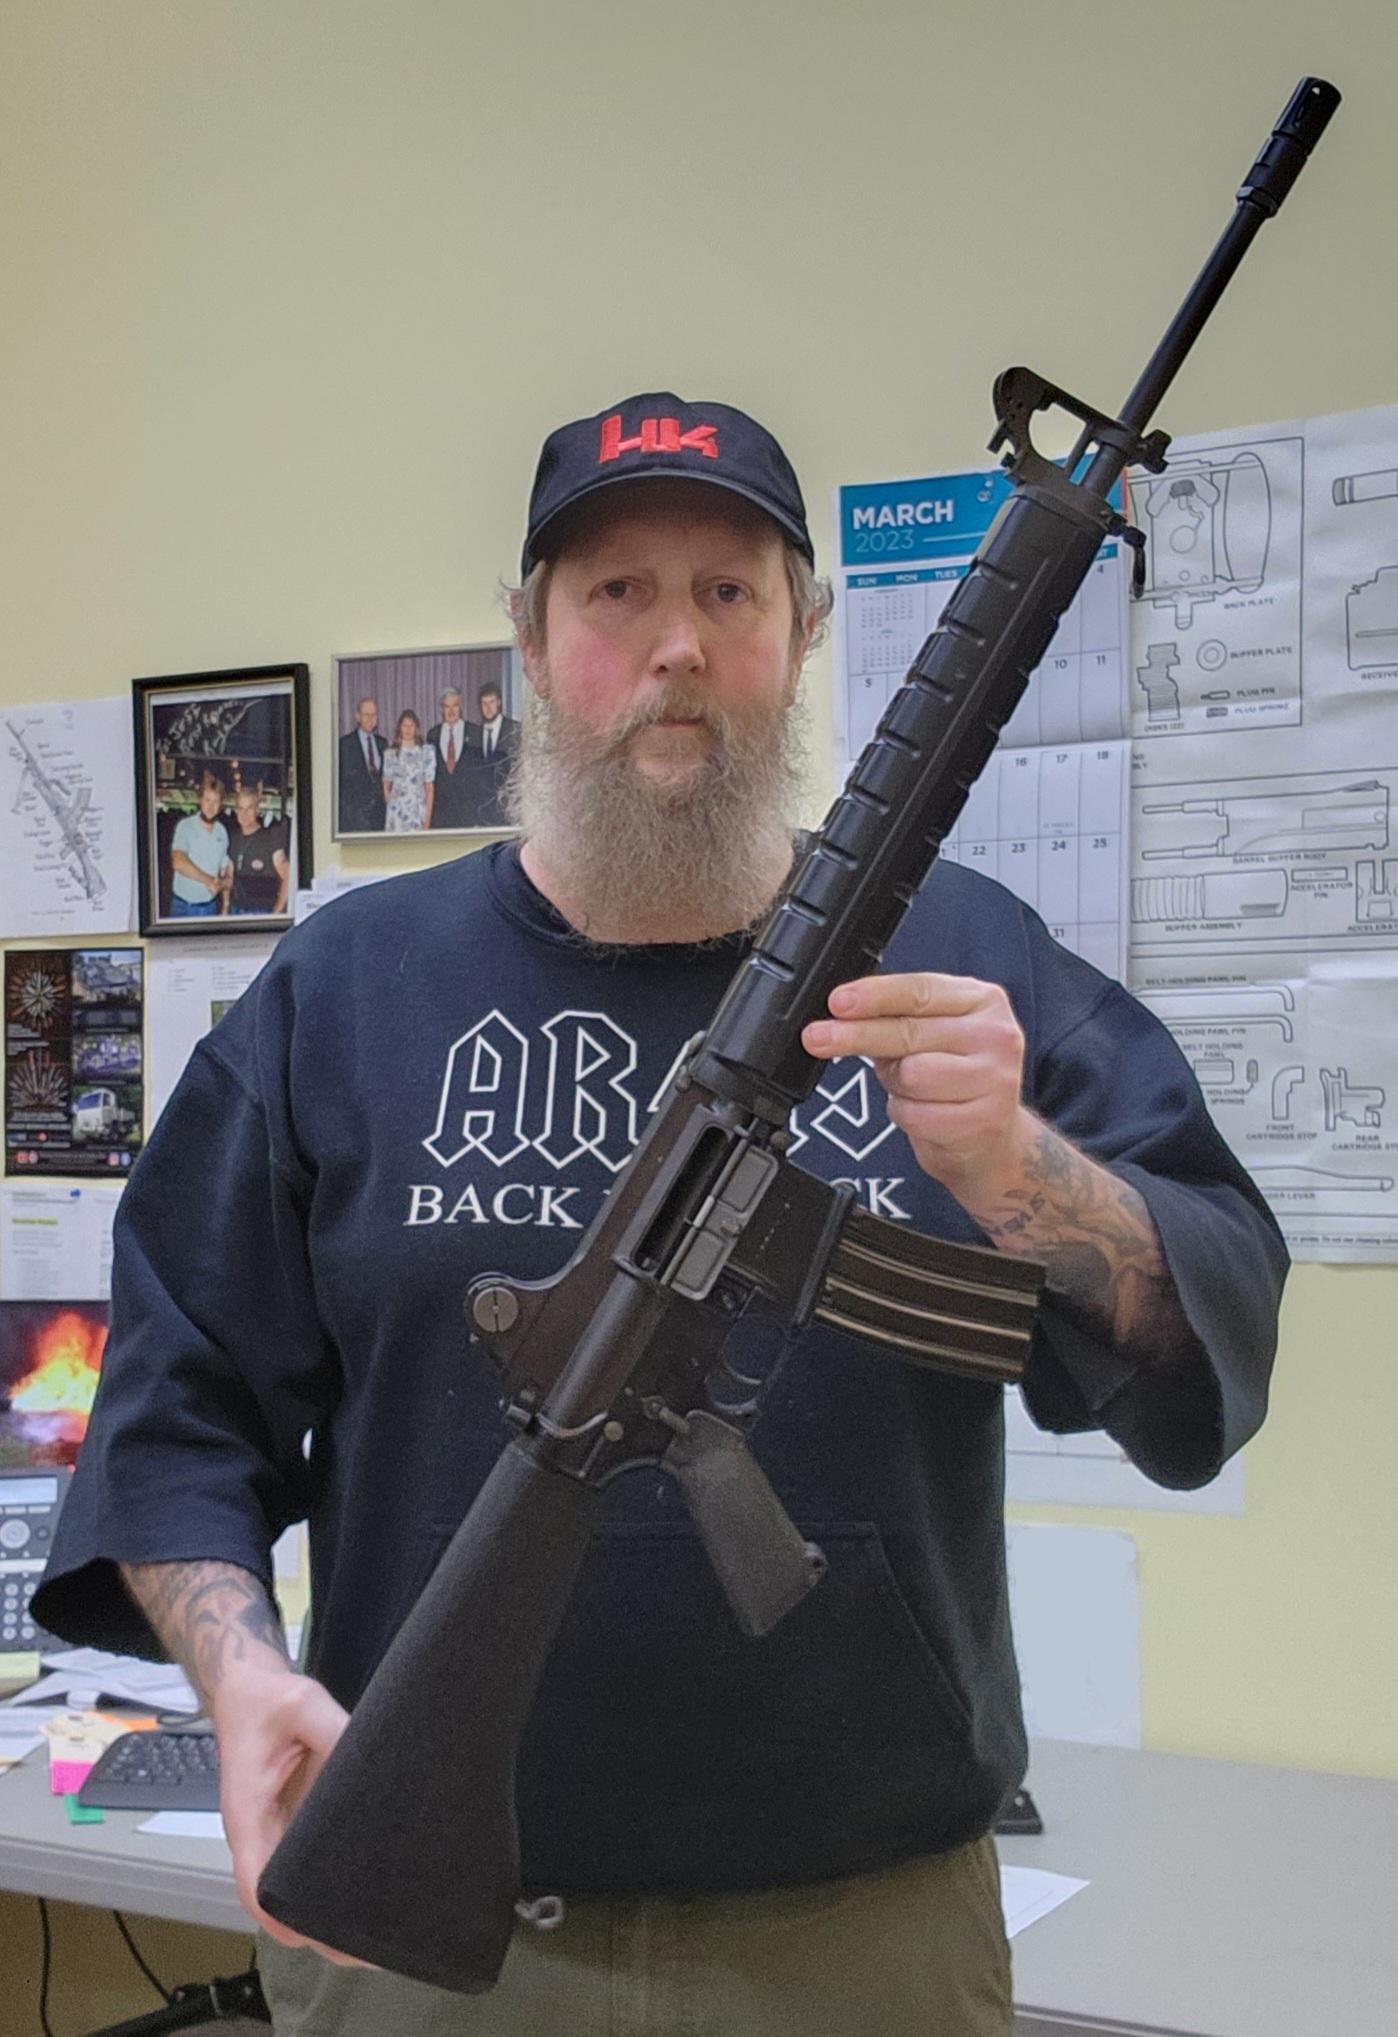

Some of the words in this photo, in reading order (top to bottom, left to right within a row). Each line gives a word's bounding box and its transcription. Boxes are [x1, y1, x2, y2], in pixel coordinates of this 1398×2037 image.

[853, 499, 954, 530] MARCH
[855, 529, 915, 553] 2023
[857, 577, 877, 586] SUN
[896, 573, 918, 583] MON
[1054, 659, 1068, 670] 10
[1096, 655, 1106, 665] 11
[864, 678, 872, 689] 5
[1015, 757, 1028, 767] 16
[1056, 754, 1068, 764] 17
[1097, 751, 1109, 761] 18
[972, 845, 986, 856] 22
[1012, 843, 1026, 853] 23
[1051, 840, 1067, 851] 24
[1092, 838, 1108, 849] 25
[1053, 928, 1065, 938] 31
[422, 1008, 897, 1173] ARS
[402, 1183, 585, 1229] BACK
